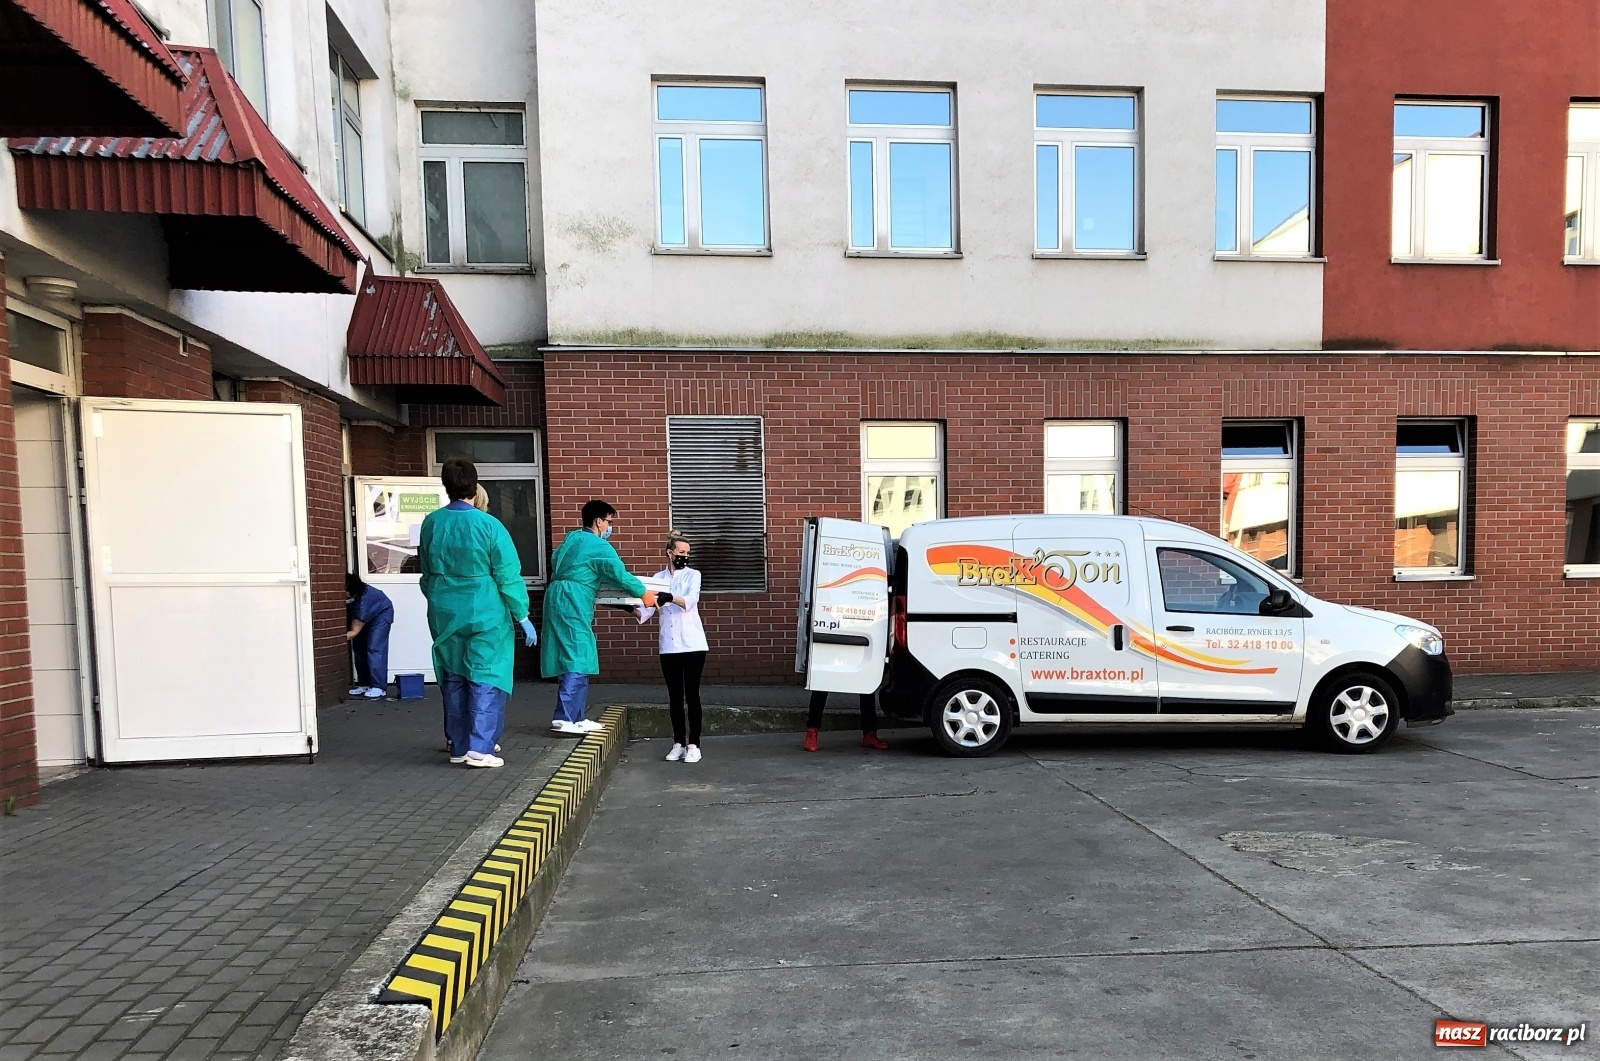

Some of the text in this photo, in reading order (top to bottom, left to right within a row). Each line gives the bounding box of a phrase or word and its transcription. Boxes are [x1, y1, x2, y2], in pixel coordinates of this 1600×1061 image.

[402, 495, 437, 504] WYJŚCIE
[822, 605, 834, 613] Tel.
[835, 606, 844, 614] 32
[1247, 628, 1273, 636] RYNEK
[1274, 628, 1292, 636] 13/5
[1020, 637, 1087, 647] RESTAURACJE
[1205, 639, 1293, 650] Tel. 32 418 10 00
[1020, 651, 1070, 660] CATERING
[1031, 667, 1144, 682] www.braxton.pl
